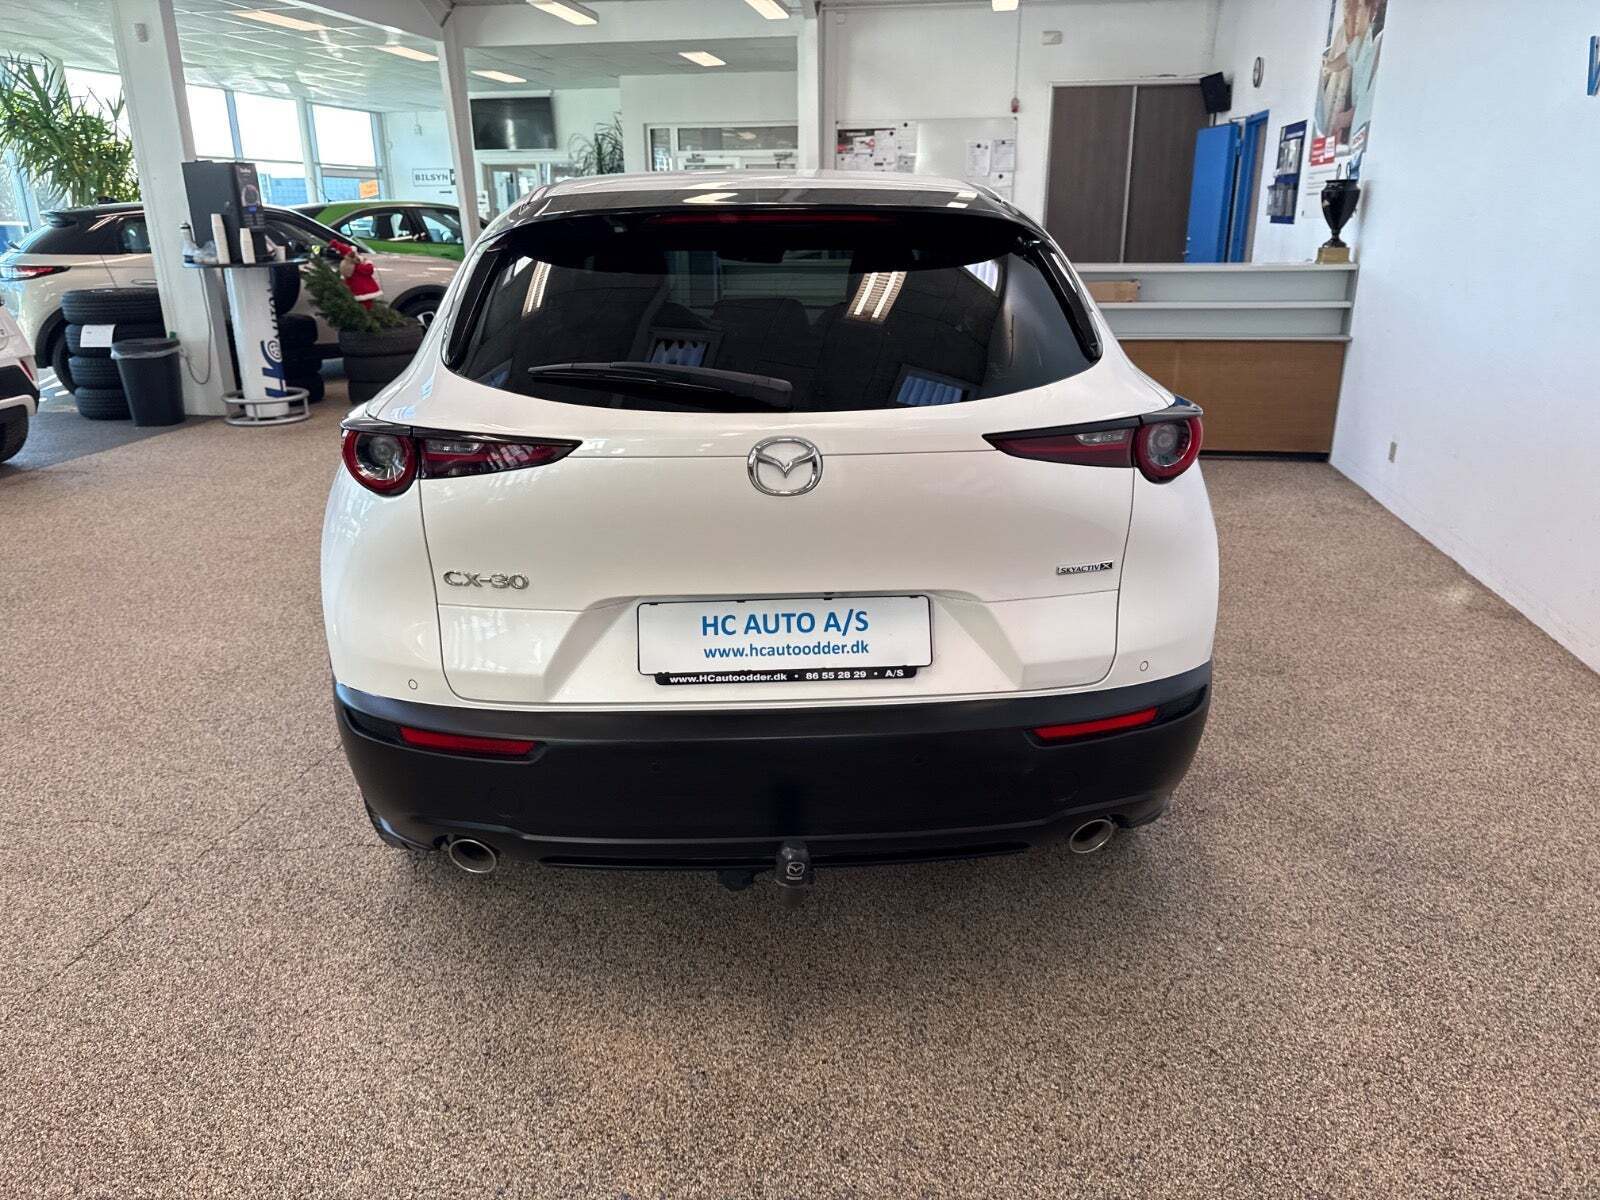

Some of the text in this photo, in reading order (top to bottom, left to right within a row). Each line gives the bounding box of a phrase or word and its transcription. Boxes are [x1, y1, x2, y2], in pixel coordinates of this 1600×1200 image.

[415, 173, 449, 181] BILSYN
[443, 571, 529, 590] CX-30
[701, 608, 870, 637] HC AUTO A/S
[703, 640, 870, 659] www.hcautoodder.dk
[669, 669, 904, 684] www.HCautoodder.dk 86 55 28 29 A/S
